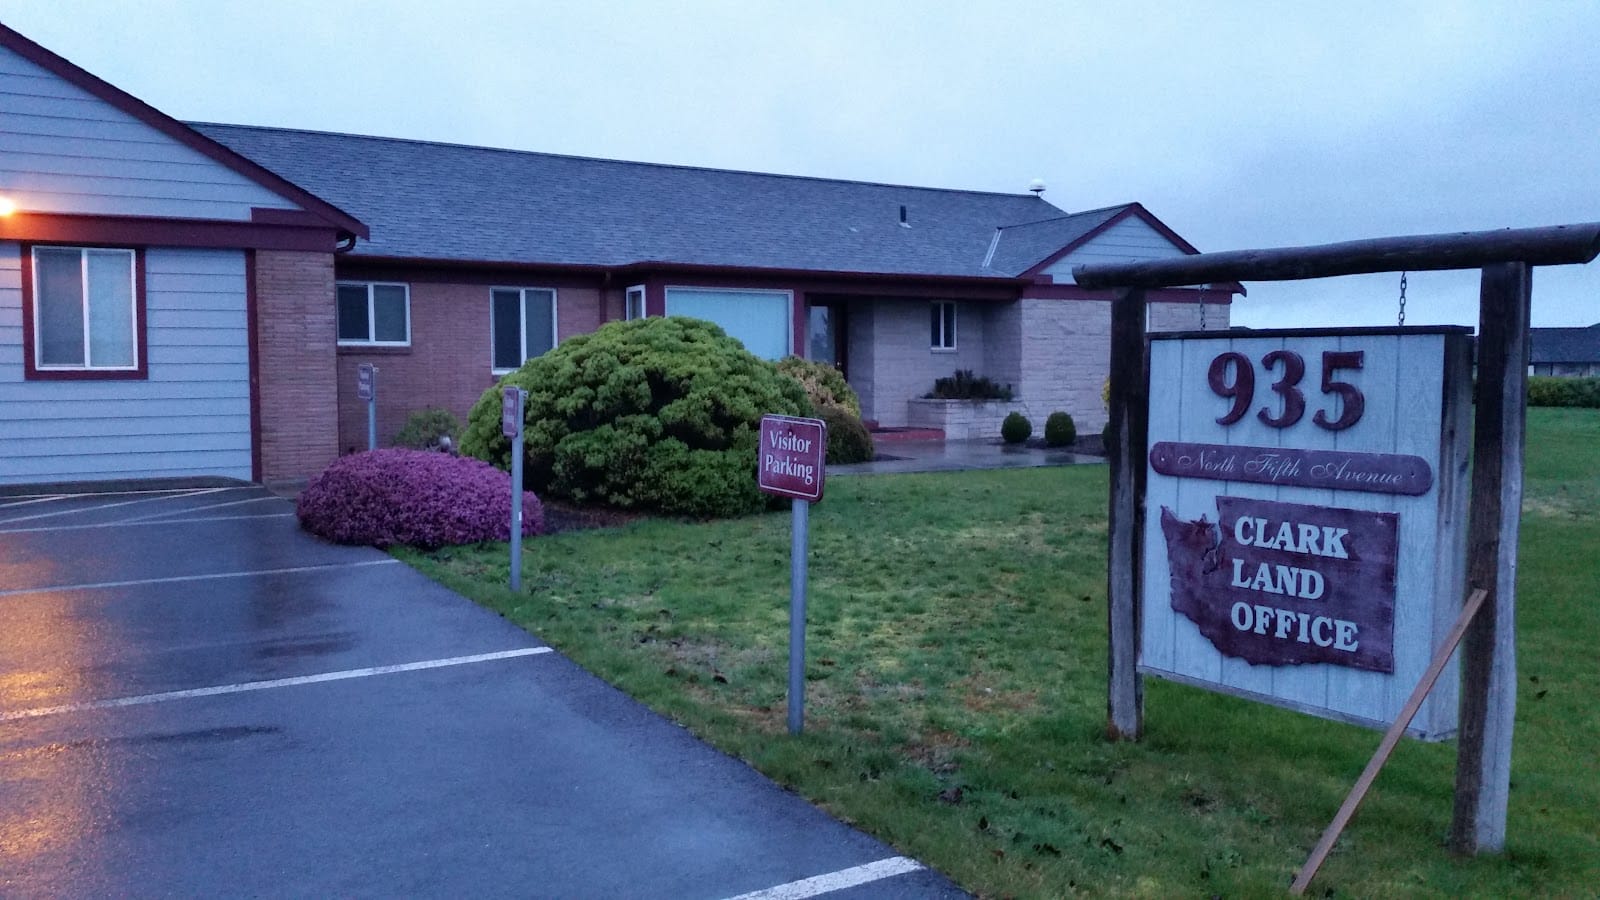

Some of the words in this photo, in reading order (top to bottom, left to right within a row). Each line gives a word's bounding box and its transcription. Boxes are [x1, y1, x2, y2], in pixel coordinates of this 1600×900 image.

[1207, 350, 1365, 431] 935
[769, 430, 812, 453] Visitor
[765, 454, 813, 485] Parking
[1177, 447, 1236, 474] North
[1243, 454, 1301, 481] Fifth
[1310, 461, 1403, 483] Avenue
[1234, 515, 1349, 559] CLARK
[1231, 559, 1325, 600] LAND
[1230, 601, 1359, 652] OFFICE
